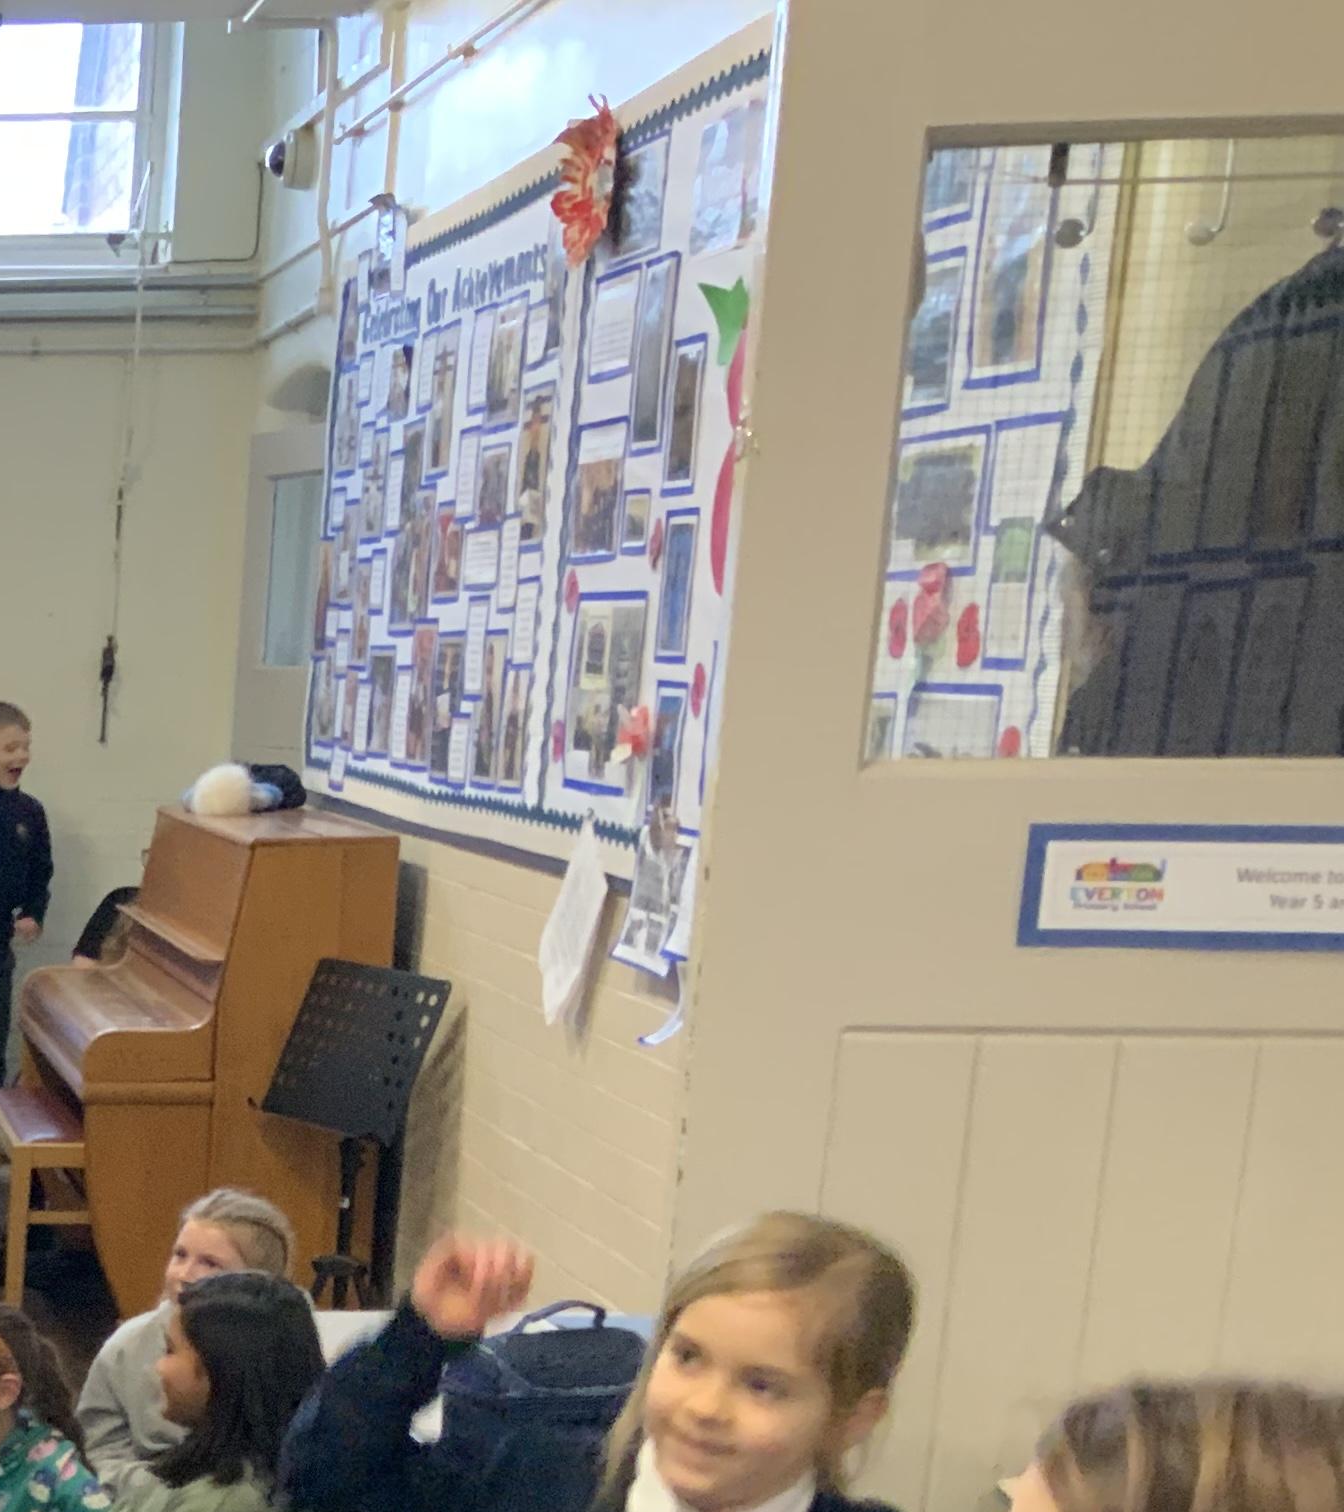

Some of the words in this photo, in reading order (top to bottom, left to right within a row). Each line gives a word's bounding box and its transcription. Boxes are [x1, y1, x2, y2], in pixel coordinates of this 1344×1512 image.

[426, 278, 448, 325] Our
[452, 243, 547, 312] Achievements
[1236, 867, 1321, 884] Welcome
[1269, 894, 1308, 909] Year
[1314, 894, 1324, 909] 5
